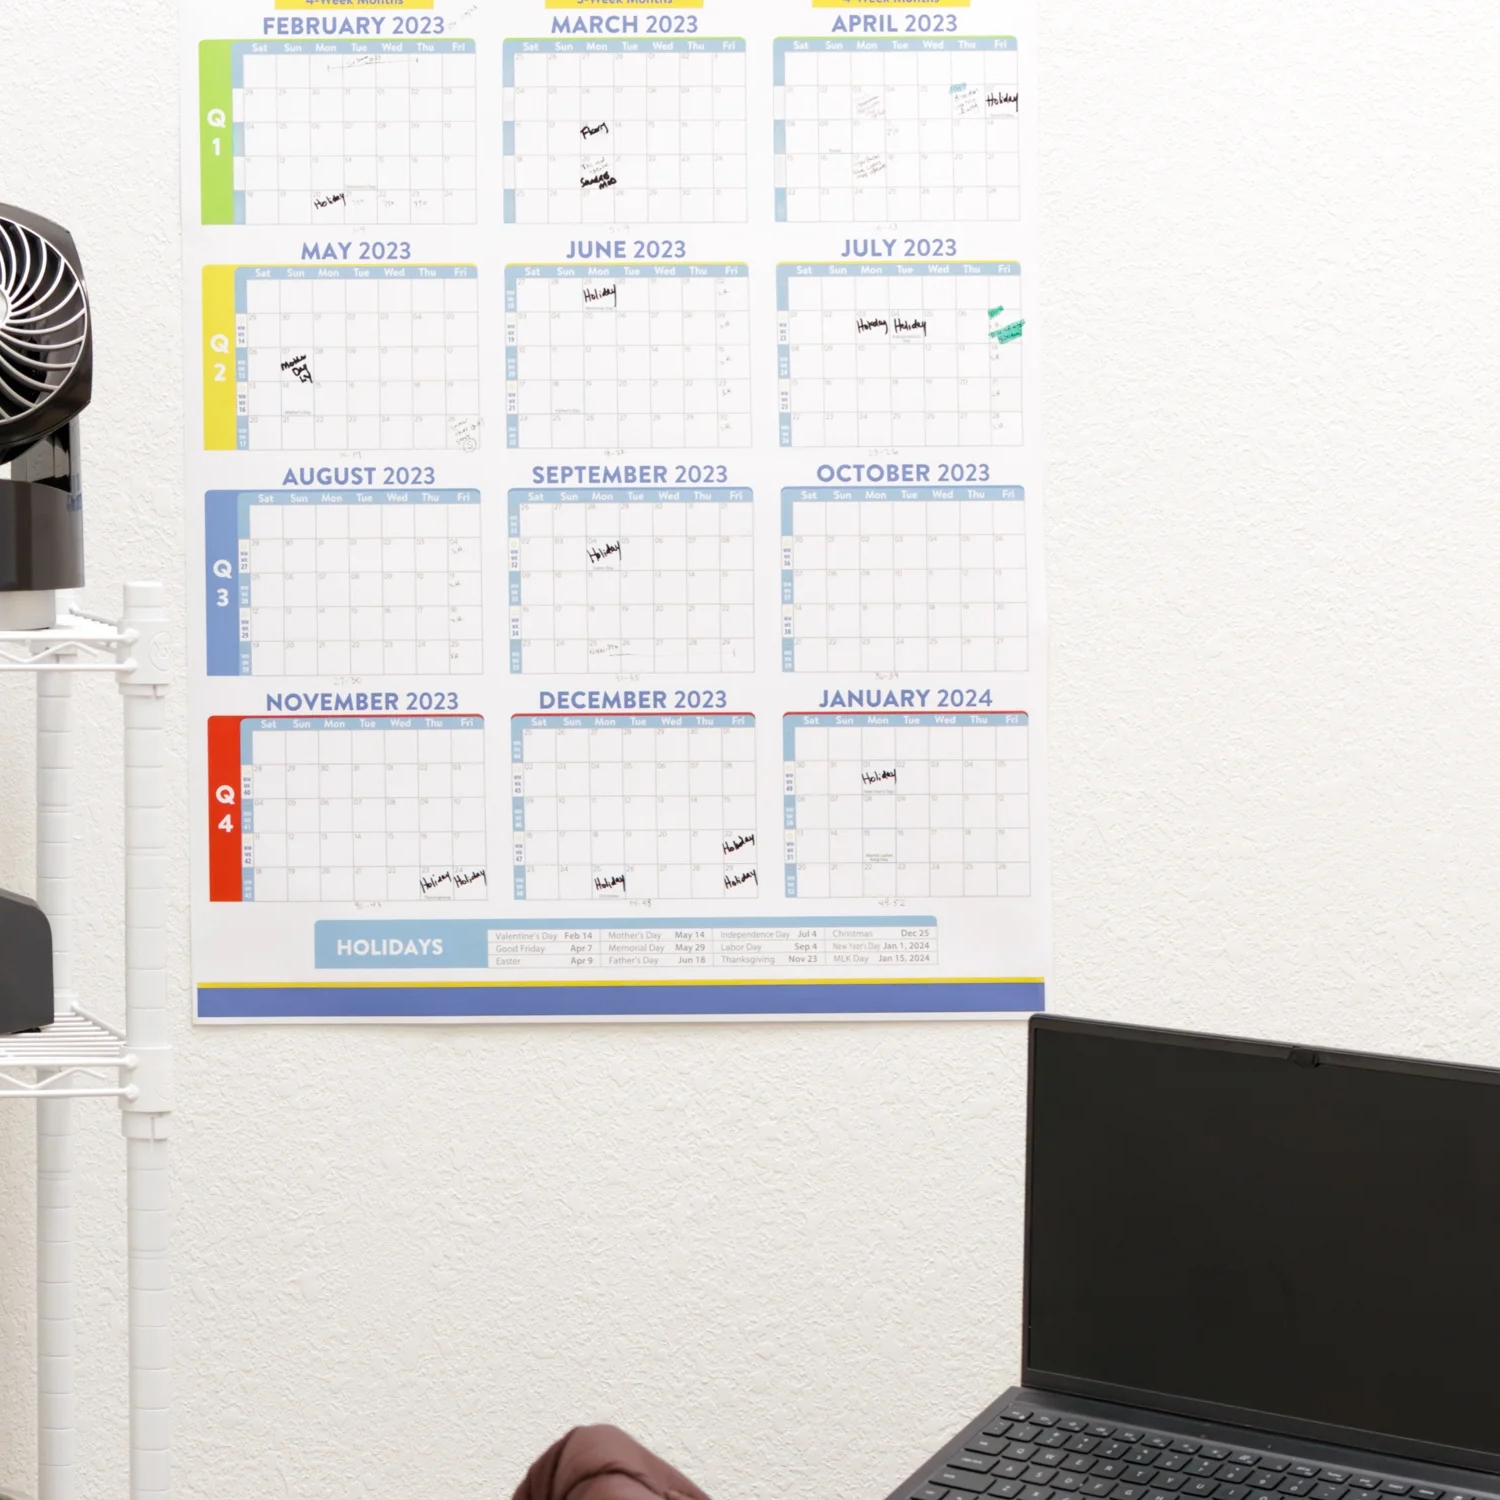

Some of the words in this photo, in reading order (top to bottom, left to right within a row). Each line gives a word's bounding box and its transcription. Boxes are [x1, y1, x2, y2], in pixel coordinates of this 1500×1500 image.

[263, 16, 386, 35] FEBRUARY
[392, 15, 445, 35] 2023
[551, 15, 638, 34] MARCH
[645, 14, 698, 34] 2023
[831, 14, 899, 33] APRIL
[904, 13, 958, 33] 2023
[252, 43, 268, 52] Sat
[284, 43, 302, 52] Sun
[315, 43, 337, 52] Mon
[351, 43, 368, 52] Tue
[381, 43, 403, 52] Wed
[417, 43, 435, 51] Thu
[452, 42, 465, 51] Fri
[986, 92, 1019, 112] Holiday
[207, 108, 226, 128] Q
[212, 138, 221, 156] 1
[314, 193, 346, 210] Holiday
[301, 241, 353, 261] MAY
[358, 241, 411, 260] 2023
[566, 240, 627, 259] JUNE
[633, 239, 686, 259] 2023
[840, 238, 897, 258] JULY
[903, 238, 957, 257] 2023
[583, 284, 617, 307] Holiday
[894, 318, 927, 337] Holiday
[210, 334, 229, 354] Q
[214, 362, 226, 381] 2
[282, 466, 377, 486] AUGUST
[382, 466, 436, 485] 2023
[532, 465, 668, 485] SEPTEMBER
[674, 464, 728, 484] 2023
[816, 463, 930, 483] OCTOBER
[937, 463, 990, 482] 2023
[801, 490, 817, 500] Sat
[833, 490, 852, 500] Sun
[865, 490, 887, 500] Mon
[901, 490, 918, 499] Tue
[932, 490, 954, 499] Wed
[967, 490, 985, 499] Thu
[1002, 489, 1015, 498] Fri
[587, 541, 622, 564] Holiday
[213, 559, 232, 579] Q
[216, 588, 229, 607] 3
[266, 692, 399, 712] NOVEMBER
[406, 691, 459, 711] 2023
[539, 690, 667, 710] DECEMBER
[674, 689, 727, 709] 2023
[818, 689, 931, 708] JANUARY
[937, 688, 993, 708] 2024
[861, 768, 897, 785] Holiday
[215, 785, 235, 805] Q
[217, 814, 234, 833] 4
[420, 871, 452, 894] Holiday
[453, 869, 488, 888] Holiday
[594, 874, 626, 892] Holiday
[723, 869, 758, 889] Holiday
[496, 932, 540, 941] Valentine's
[541, 932, 558, 943] Day
[564, 931, 581, 940] Feb
[582, 931, 593, 940] 14
[608, 931, 644, 940] Mother's
[645, 931, 661, 942] Day
[674, 931, 693, 941] May
[695, 931, 705, 939] 14
[720, 930, 774, 940] Independence
[775, 930, 790, 940] Day
[798, 930, 810, 938] Jul
[811, 930, 817, 938] 4
[832, 929, 873, 938] Christmas
[900, 929, 917, 938] Dec
[918, 929, 930, 938] 25
[337, 938, 444, 956] HOLIDAYS
[495, 944, 519, 953] Good
[520, 944, 546, 955] Friday
[570, 944, 586, 955] Apr
[587, 944, 593, 952] 7
[608, 944, 647, 952] Memorial
[648, 943, 665, 954] Day
[675, 943, 693, 954] May
[695, 943, 706, 952] 29
[720, 943, 745, 952] Labor
[746, 942, 762, 953] Day
[794, 942, 811, 953] Sep
[812, 942, 818, 951] 4
[868, 941, 881, 951] Day
[883, 942, 898, 950] Jan
[900, 942, 907, 951] 1,
[909, 941, 930, 950] 2024
[495, 957, 521, 966] Easter
[570, 956, 586, 967] Apr
[587, 956, 594, 965] 9
[608, 956, 641, 964] Father's
[642, 956, 659, 966] Day
[678, 956, 694, 964] Jun
[695, 955, 706, 964] 18
[721, 955, 776, 966] Thanksgiving
[788, 955, 806, 963] Nov
[807, 954, 818, 963] 23
[833, 954, 851, 963] MLK
[853, 954, 869, 964] Day
[878, 954, 893, 962] Jan
[895, 954, 907, 963] 15,
[909, 954, 930, 962] 2024
